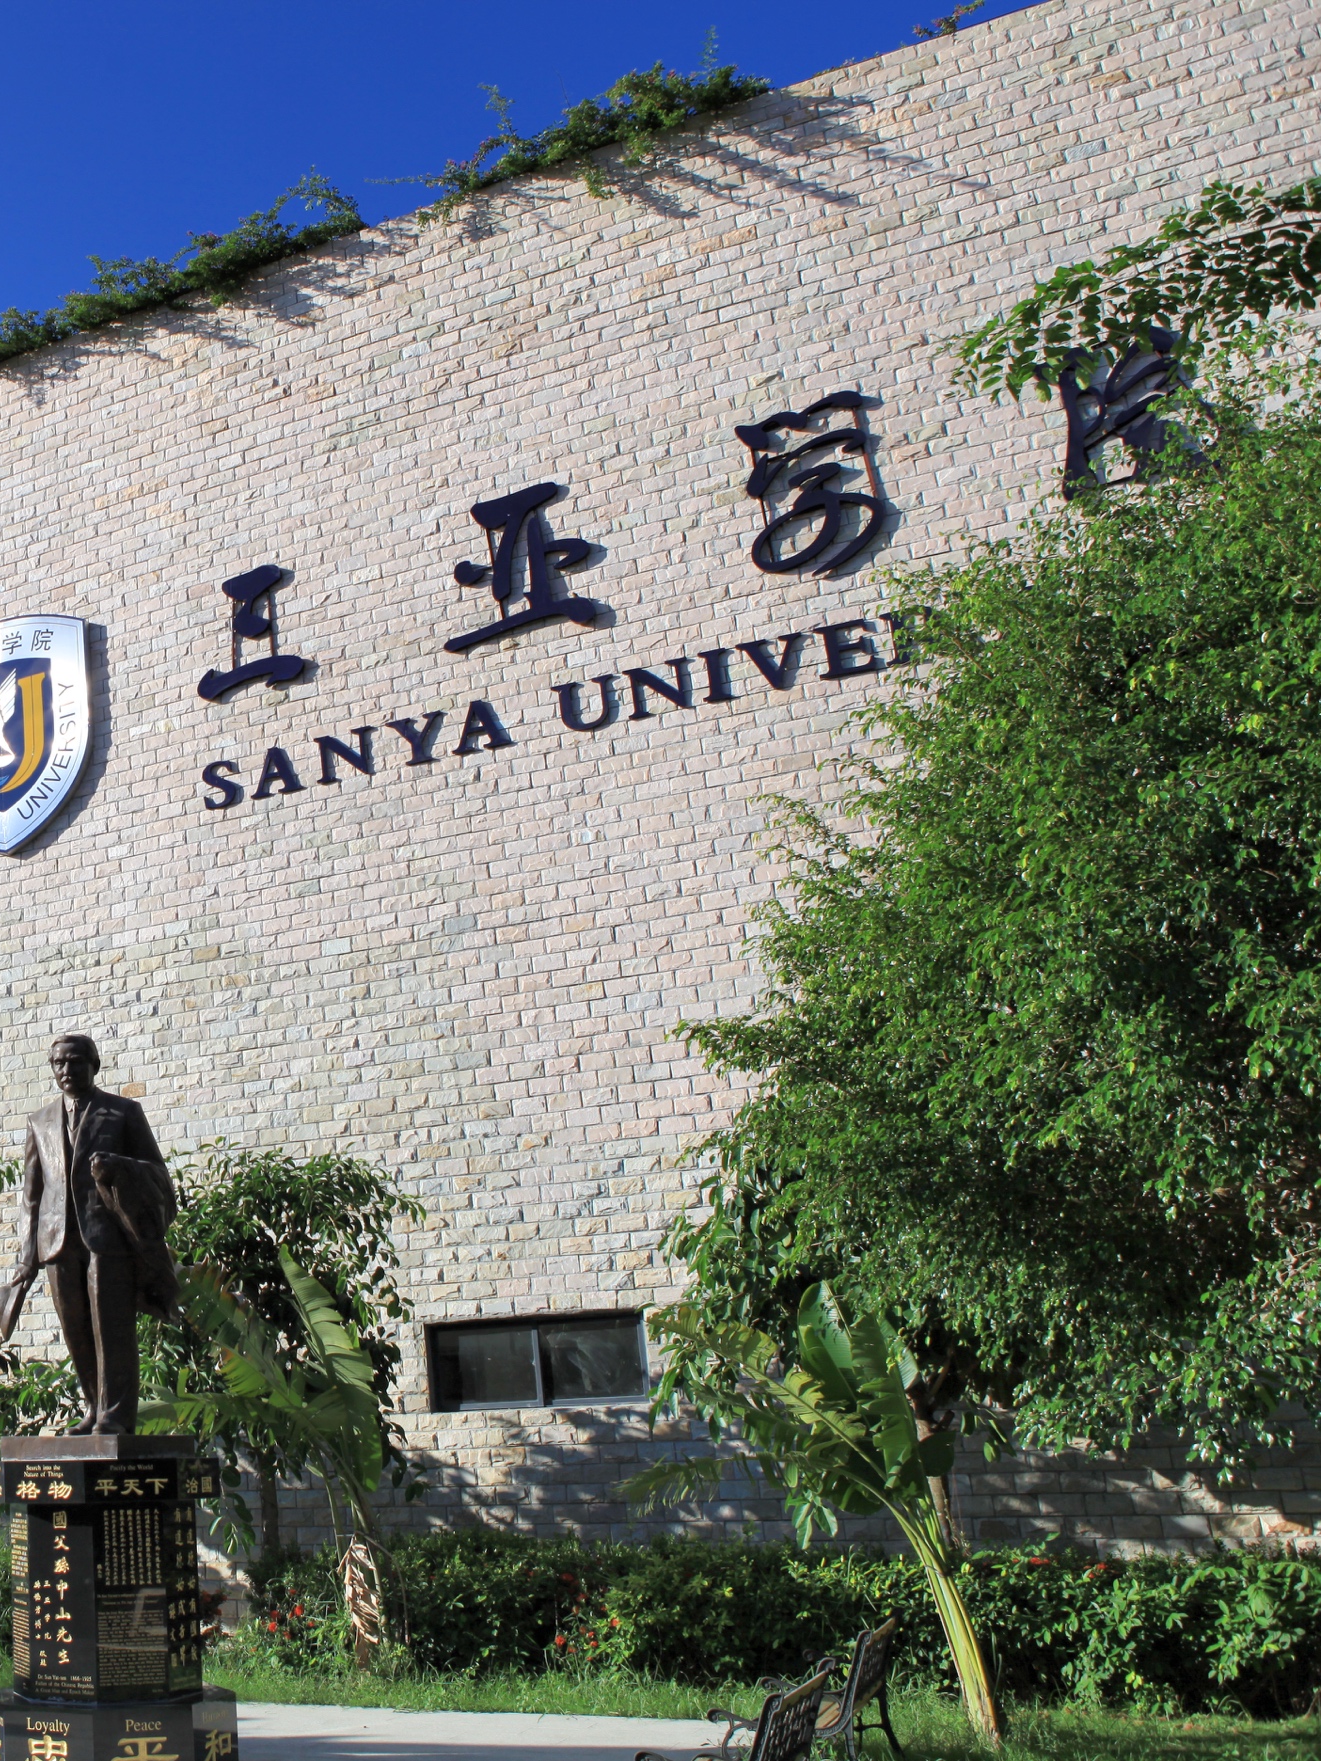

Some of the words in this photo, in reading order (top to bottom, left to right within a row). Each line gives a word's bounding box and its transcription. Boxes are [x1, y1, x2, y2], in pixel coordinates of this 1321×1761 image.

[202, 699, 516, 810] SANYA
[15, 1480, 73, 1499] 格物
[95, 1478, 168, 1497] 平天下
[185, 1476, 212, 1494] 治國
[26, 1716, 70, 1736] Loyalty
[124, 1719, 162, 1732] Peace
[204, 1728, 232, 1761] 和
